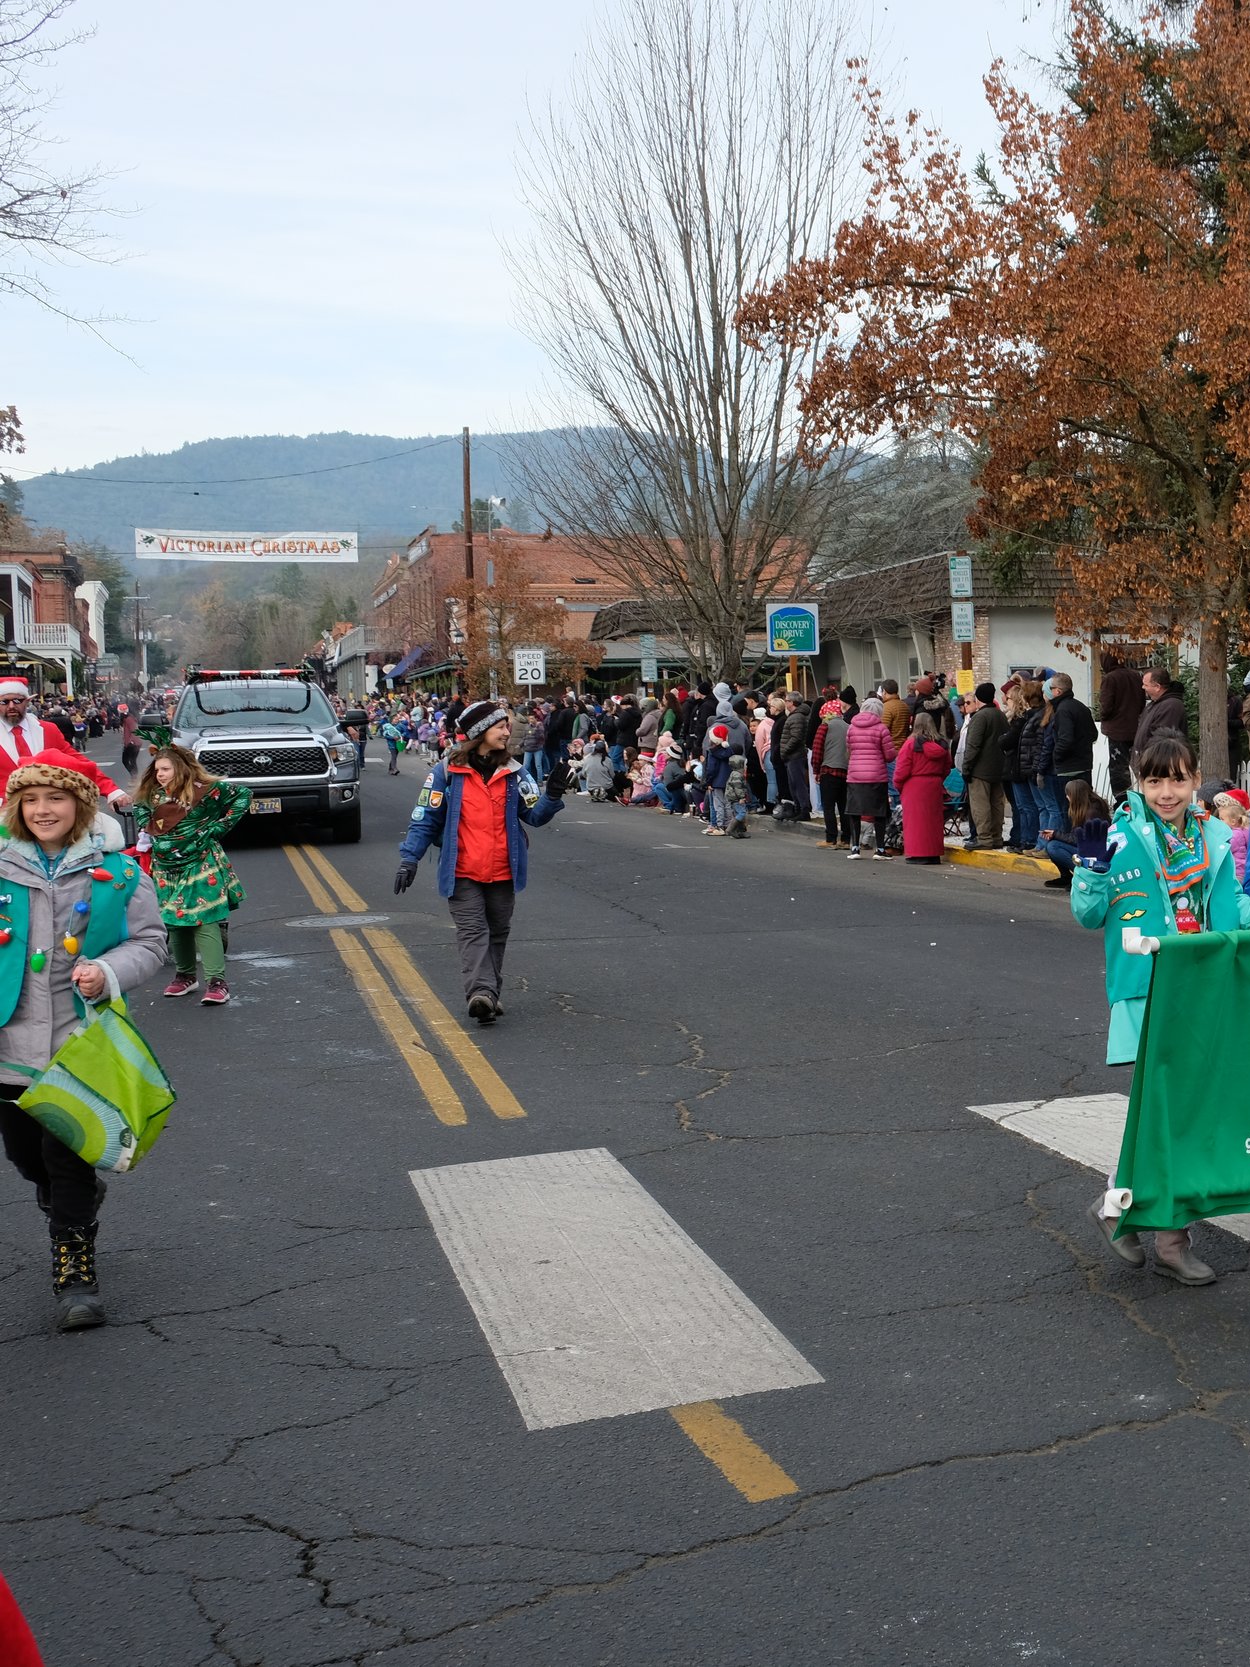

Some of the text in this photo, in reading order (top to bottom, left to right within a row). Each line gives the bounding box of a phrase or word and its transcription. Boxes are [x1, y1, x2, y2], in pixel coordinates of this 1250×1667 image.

[775, 620, 810, 629] DISCOVERY
[782, 629, 805, 638] DRIVE
[518, 667, 541, 681] 20
[1110, 868, 1142, 886] 1480
